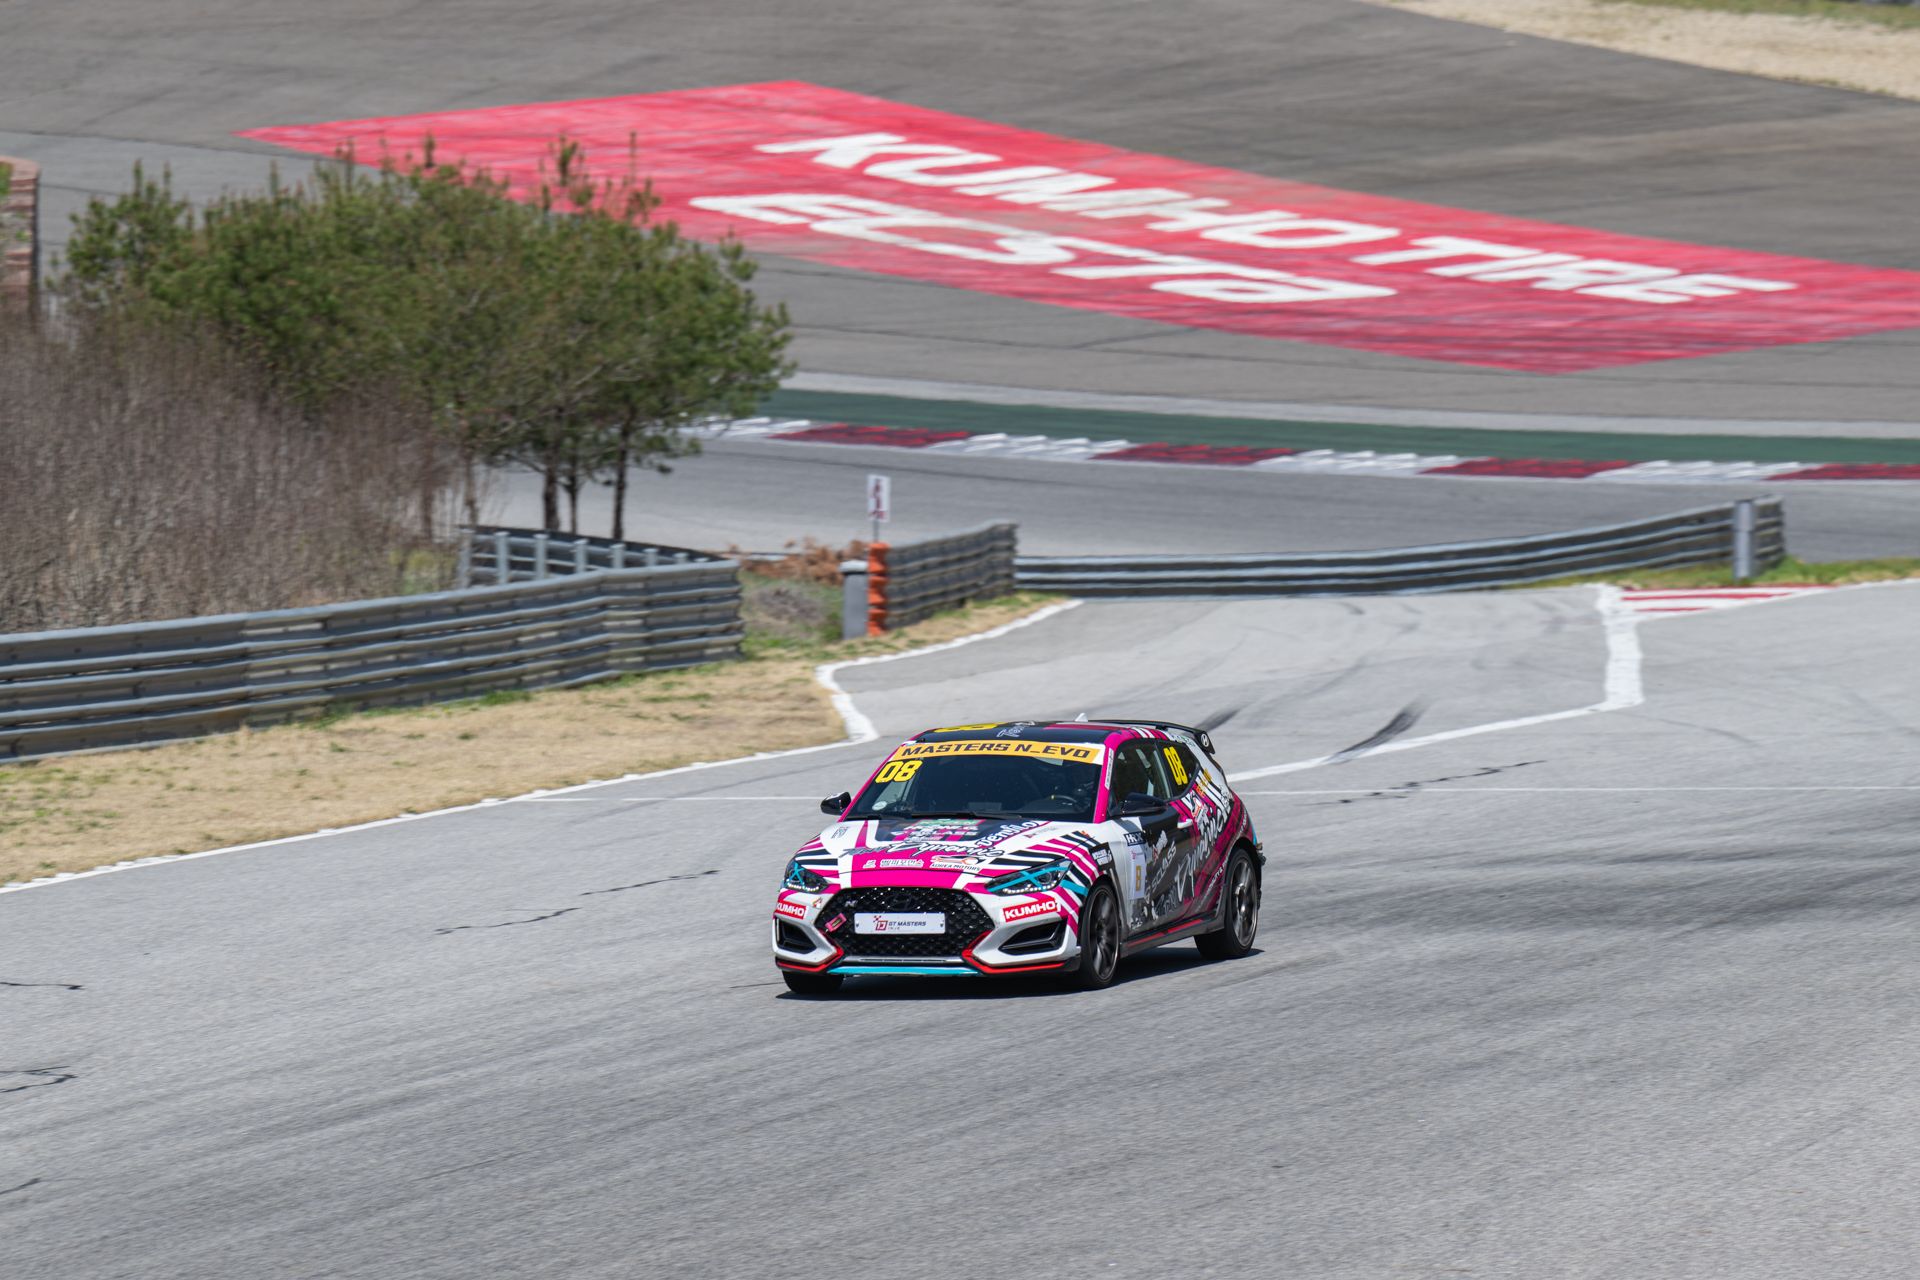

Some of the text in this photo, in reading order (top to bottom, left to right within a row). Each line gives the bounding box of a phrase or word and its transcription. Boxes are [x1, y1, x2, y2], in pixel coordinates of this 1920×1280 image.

[754, 132, 1797, 304] KUMHO TIRE
[902, 743, 1092, 759] MASTERS N_EVO
[875, 760, 922, 784] 08
[1163, 746, 1189, 786] 08
[776, 902, 806, 917] KUMHO
[1004, 900, 1056, 920] KUMHO
